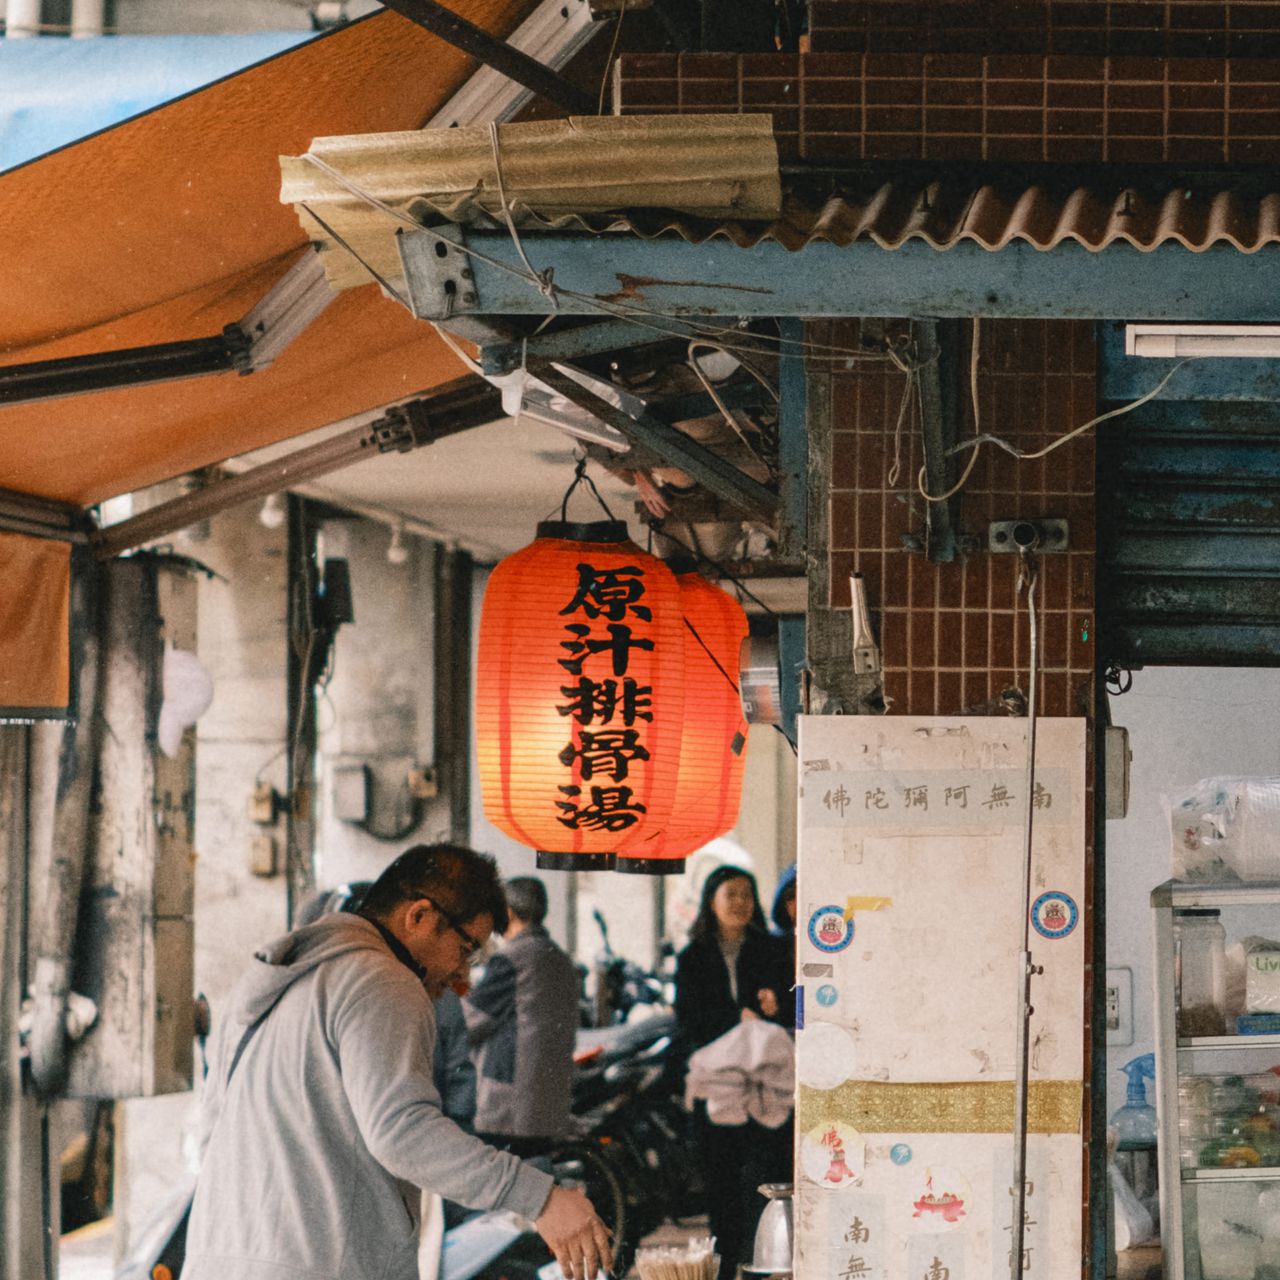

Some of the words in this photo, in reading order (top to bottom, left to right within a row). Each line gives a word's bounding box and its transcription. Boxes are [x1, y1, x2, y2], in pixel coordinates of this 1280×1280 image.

[554, 562, 655, 832] 原汁排骨湯
